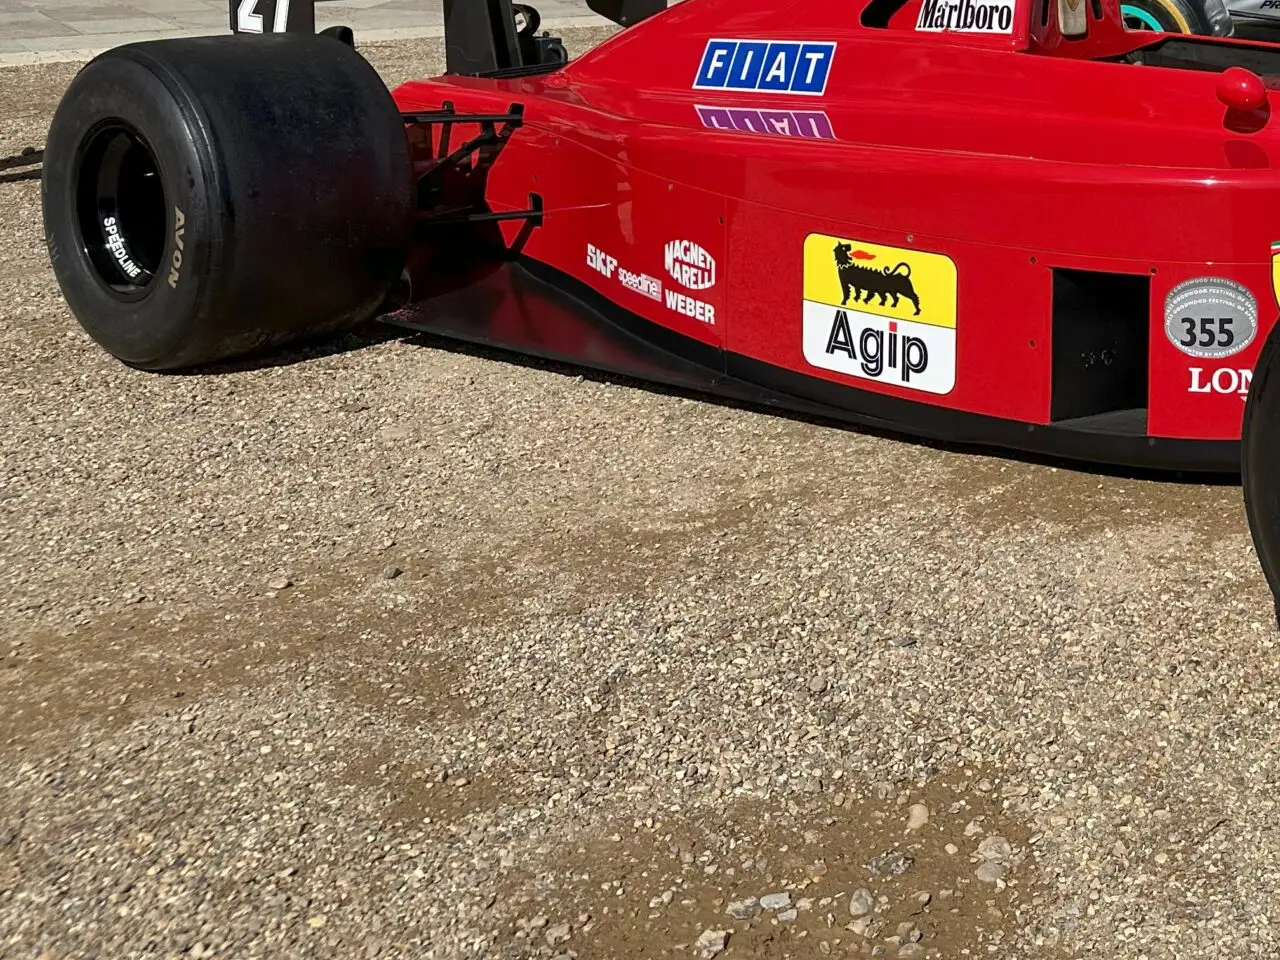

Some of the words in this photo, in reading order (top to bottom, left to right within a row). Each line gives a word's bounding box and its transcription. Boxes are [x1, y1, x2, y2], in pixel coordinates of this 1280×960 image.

[707, 49, 825, 84] FIAT
[103, 216, 142, 279] SPEEDLINE
[167, 205, 186, 289] AVON
[586, 243, 618, 278] SKF
[664, 240, 716, 271] MAGNETI
[617, 267, 661, 298] speedline
[664, 260, 716, 290] MARELLI
[664, 289, 716, 325] WEBER
[825, 309, 929, 382] Agip
[1180, 317, 1234, 347] 355
